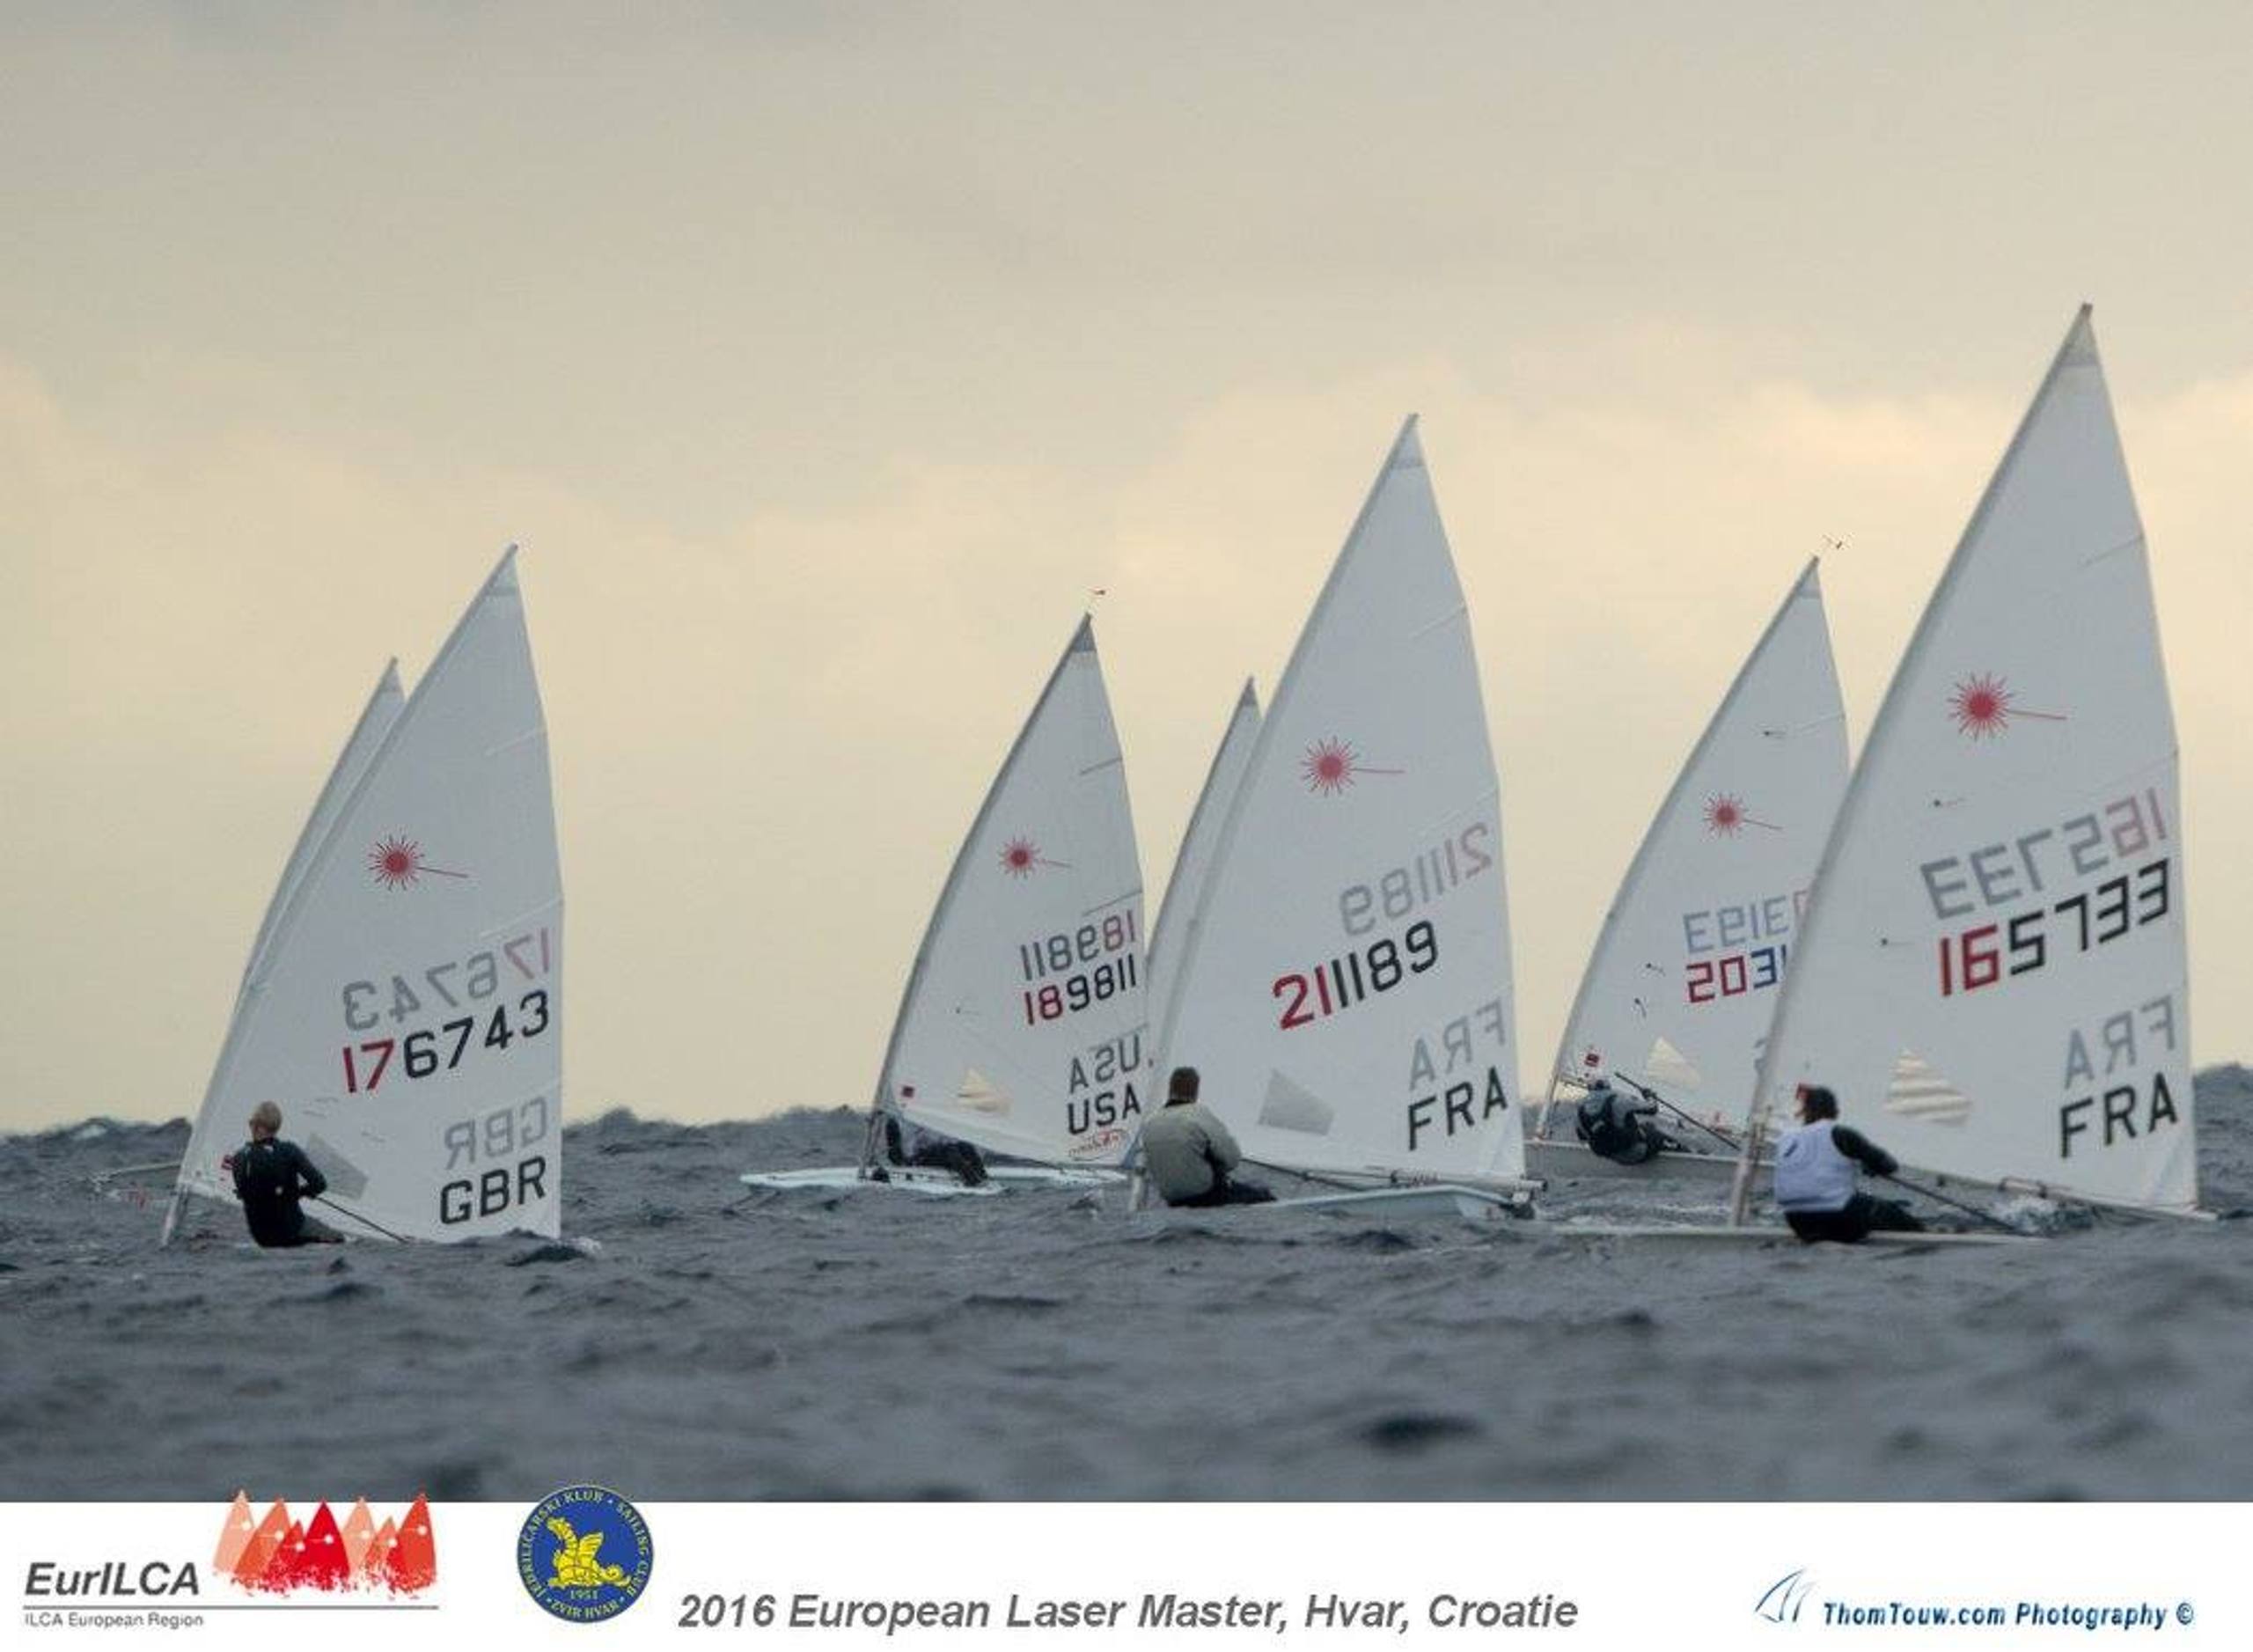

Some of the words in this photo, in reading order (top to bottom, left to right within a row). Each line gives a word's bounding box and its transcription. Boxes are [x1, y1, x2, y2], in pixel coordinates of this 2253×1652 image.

[1939, 856, 2170, 997] 165733
[1024, 953, 1137, 1026] 189811
[1272, 921, 1439, 1031] 211189
[341, 989, 550, 1094] 176743
[1068, 1083, 1141, 1135] USA
[1408, 1066, 1508, 1151] FRA
[2059, 1071, 2178, 1159] FRA
[439, 1155, 547, 1226] GBR
